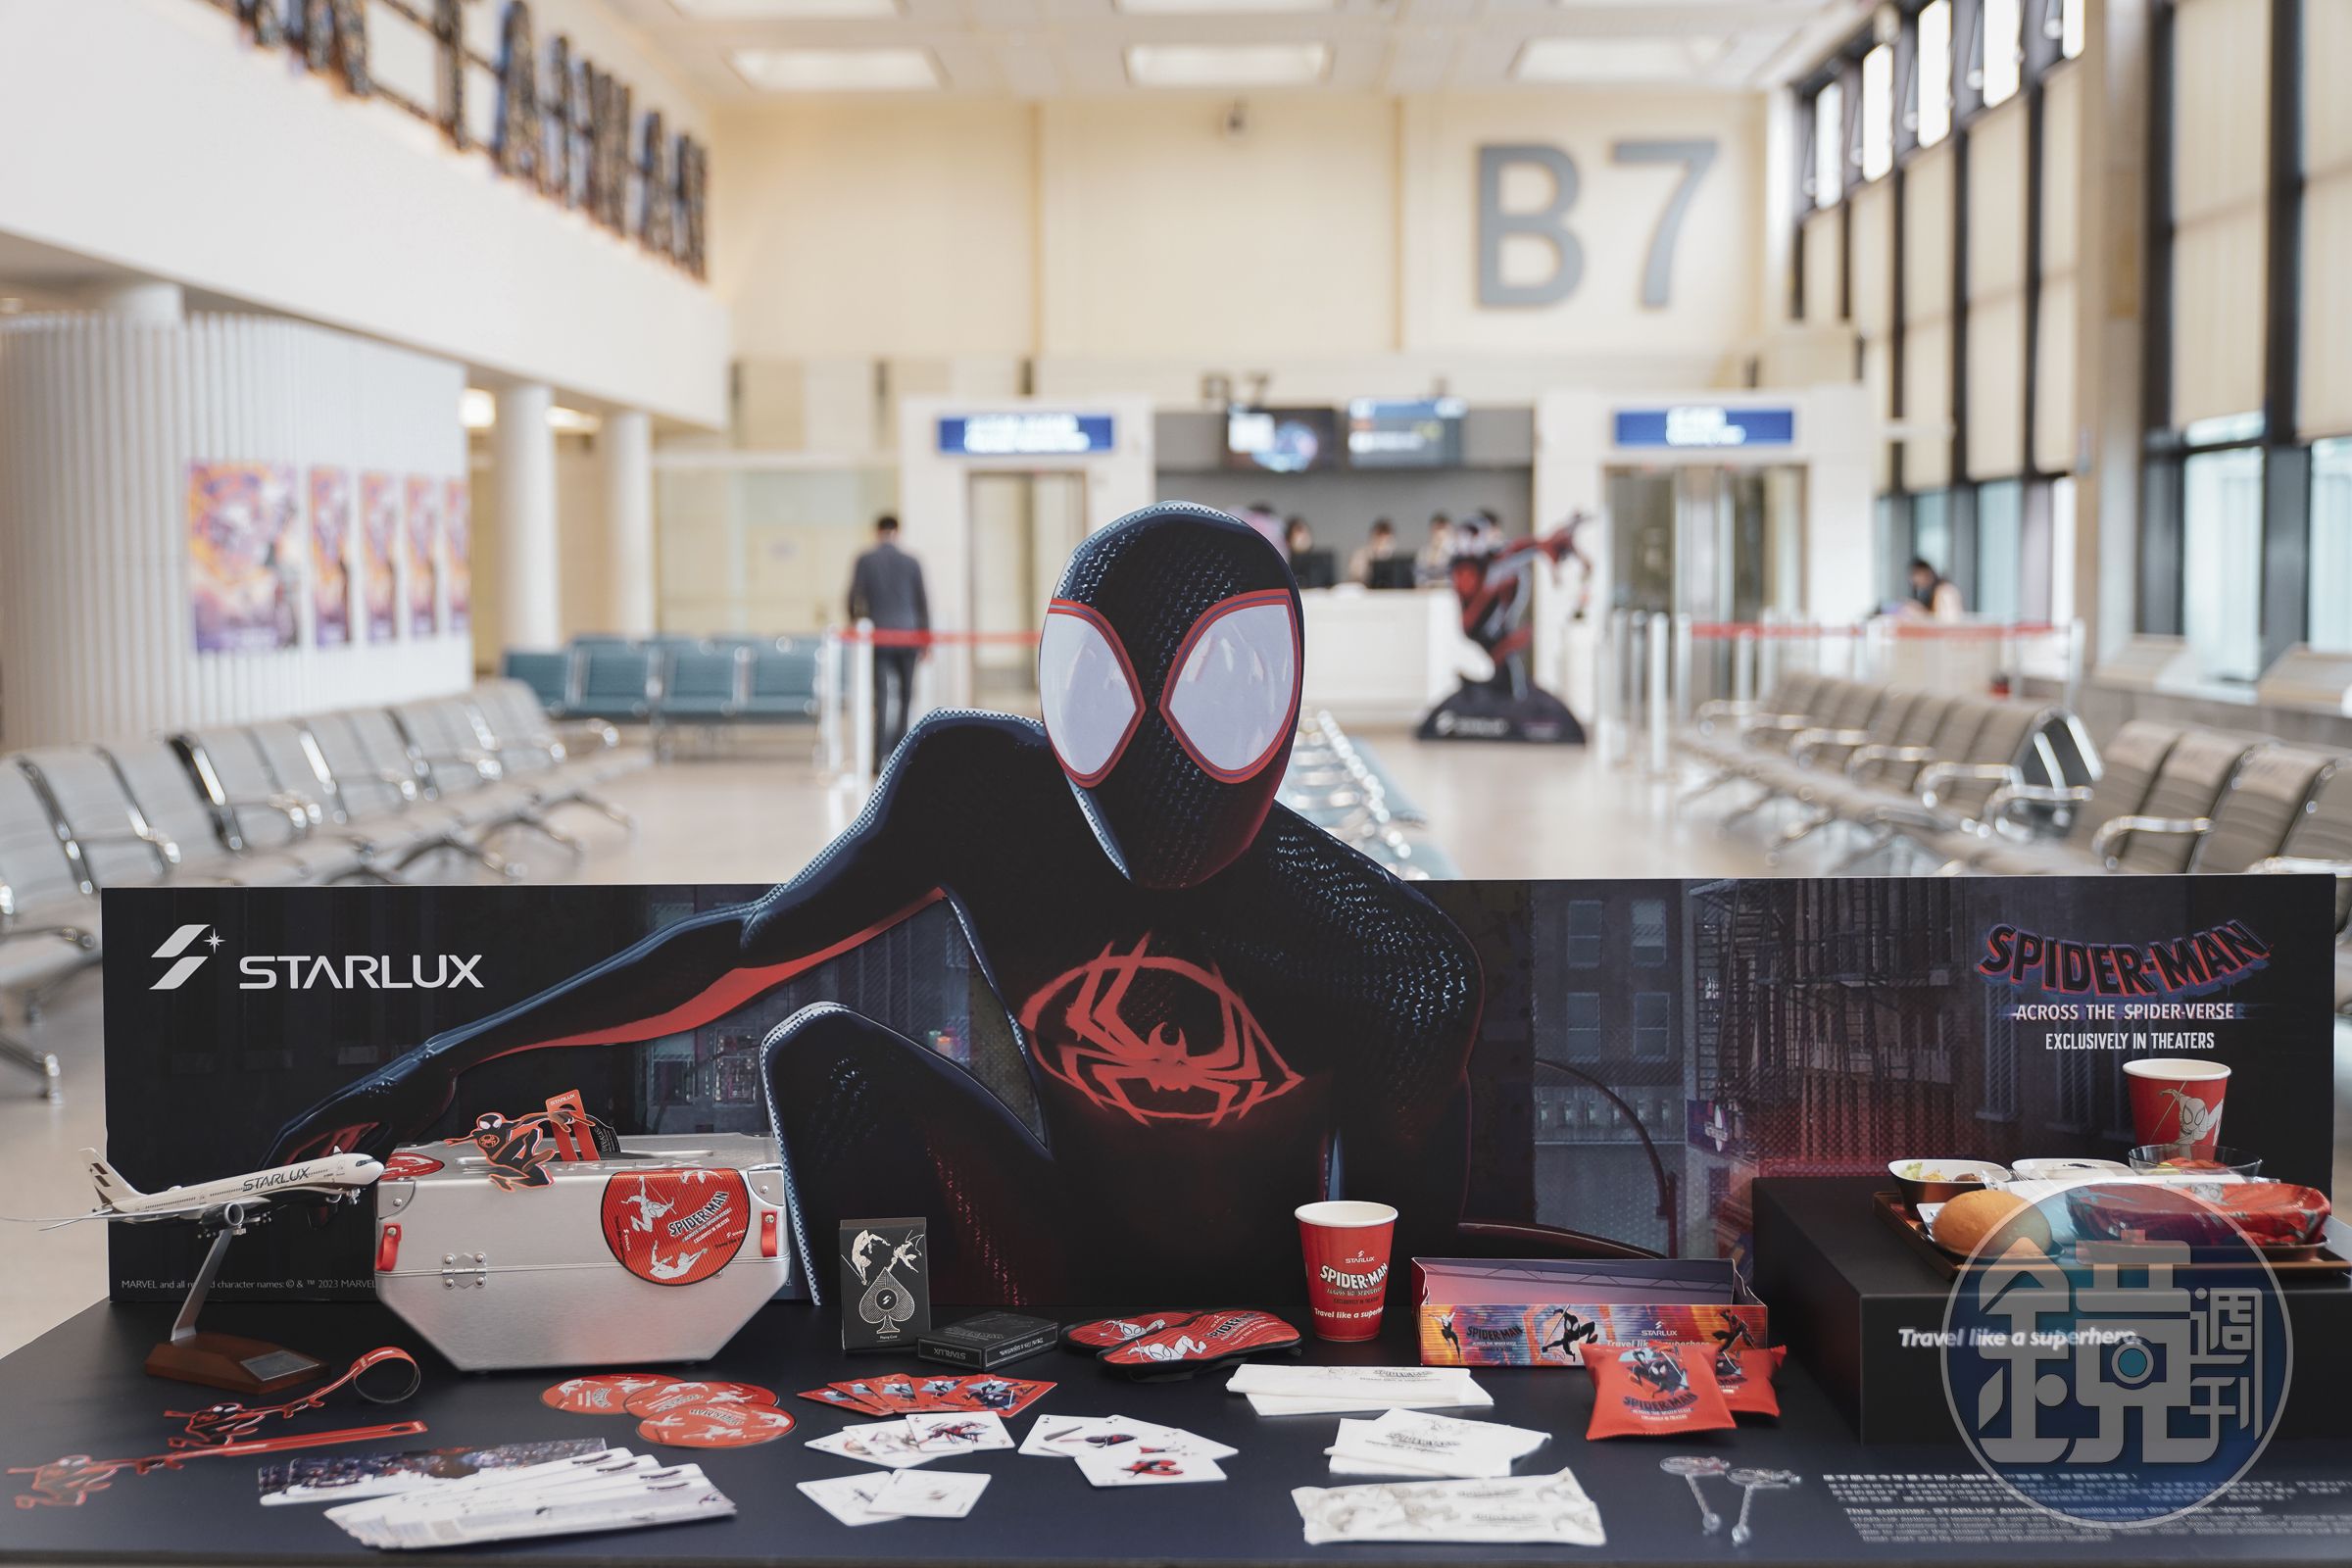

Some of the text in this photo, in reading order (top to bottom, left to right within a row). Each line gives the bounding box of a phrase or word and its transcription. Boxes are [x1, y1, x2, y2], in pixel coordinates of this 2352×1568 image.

[1976, 919, 2273, 998] SPIDER-MAN
[239, 955, 485, 990] STARLUX
[2015, 1003, 2234, 1021] ACROSS THE SPIDER-VERSE
[2045, 1031, 2215, 1051] EXCLUSIVELY IN THEATERS
[242, 1166, 311, 1193] STARLUX
[667, 1191, 730, 1238] SPIDER-MAN
[122, 1280, 157, 1289] MARVEL
[160, 1280, 174, 1289] and
[176, 1280, 185, 1289] all
[218, 1280, 254, 1289] character
[318, 1279, 339, 1289] 2023
[341, 1279, 376, 1289] MARVEL
[1314, 1307, 1334, 1318] Travel
[1898, 1326, 2143, 1351] Travel like a superhero.
